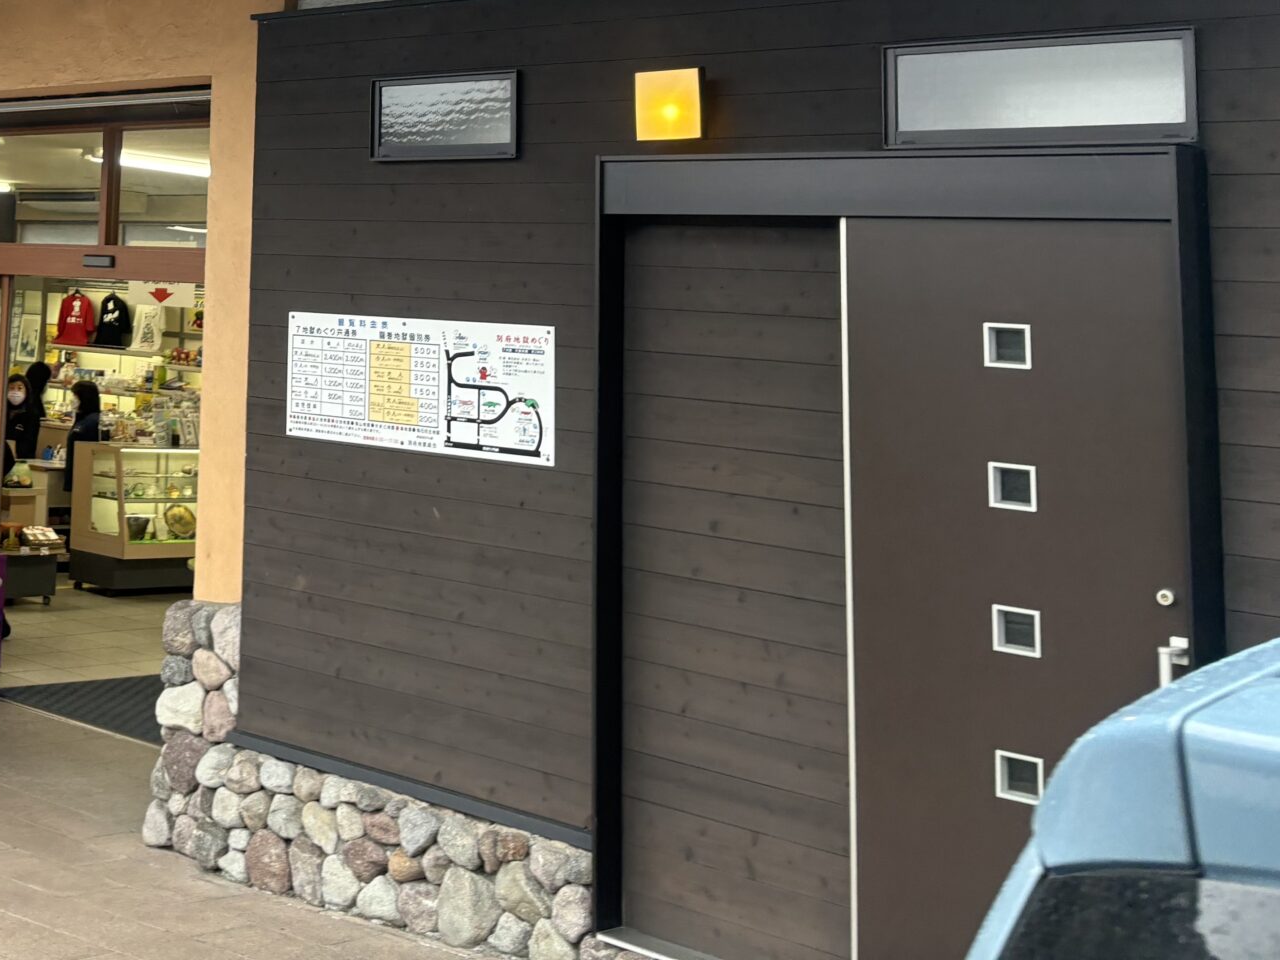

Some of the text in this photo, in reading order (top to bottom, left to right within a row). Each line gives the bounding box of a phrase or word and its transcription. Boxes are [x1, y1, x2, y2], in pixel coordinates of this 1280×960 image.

[496, 334, 548, 345] 別府地獄めぐり
